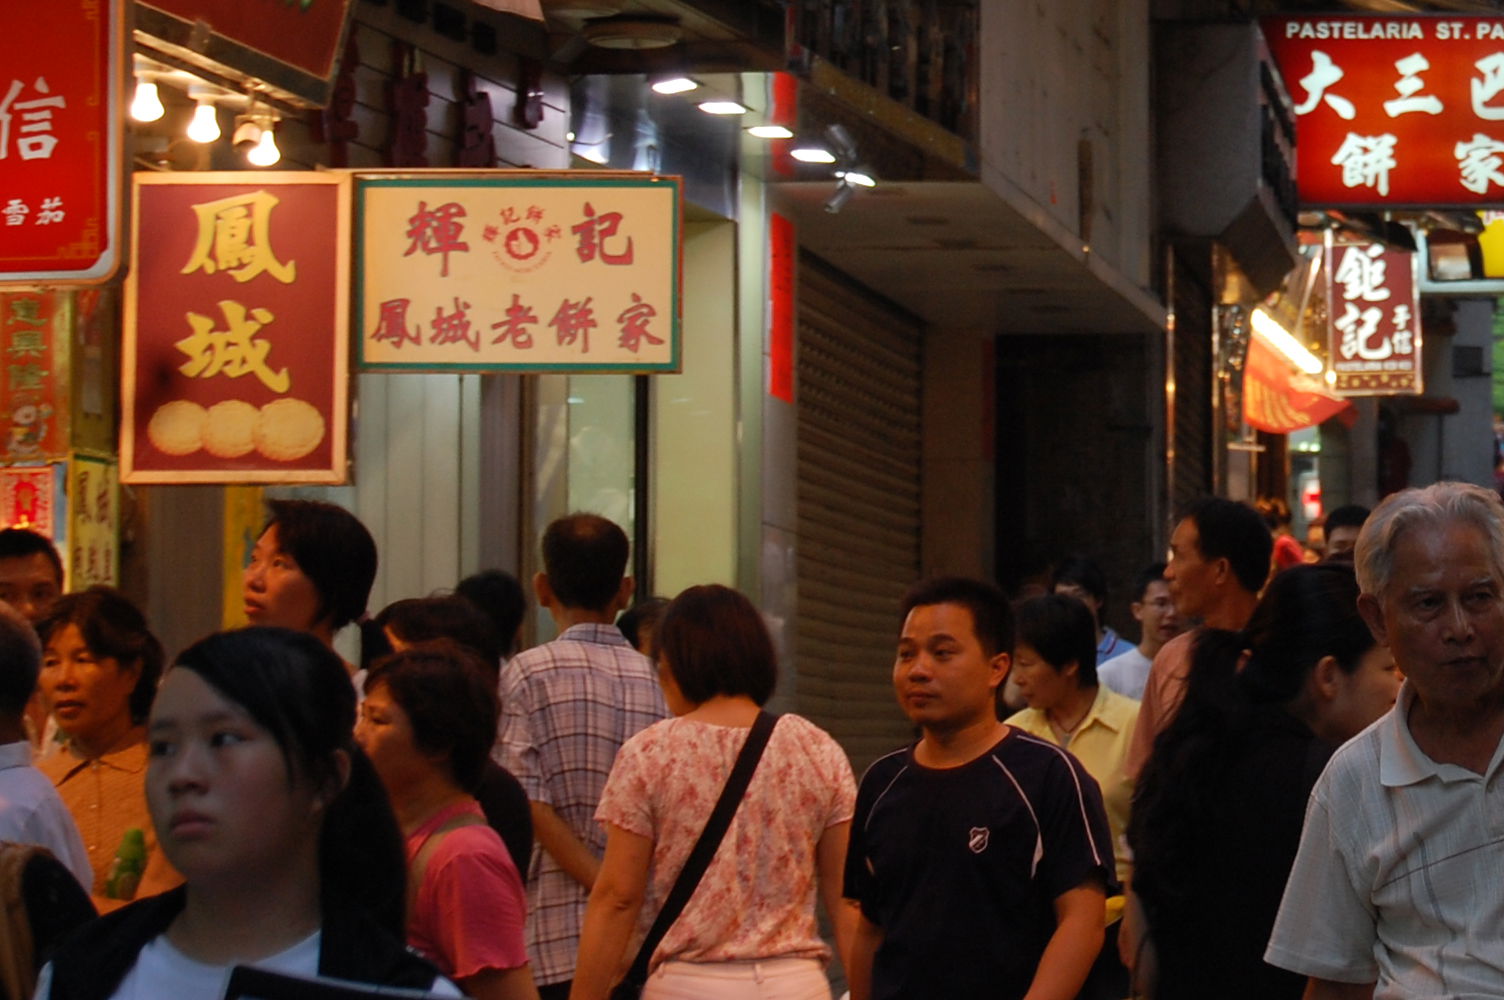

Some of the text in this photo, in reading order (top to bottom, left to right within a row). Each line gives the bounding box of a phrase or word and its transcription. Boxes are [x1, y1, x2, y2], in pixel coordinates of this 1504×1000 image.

[1285, 21, 1424, 40] PASTELARIA
[1435, 23, 1471, 40] ST.
[1, 196, 66, 226] 雪茄
[177, 190, 297, 394] 鳳城
[369, 292, 665, 353] 鳳城老餅家
[1334, 242, 1392, 360] 鉅記
